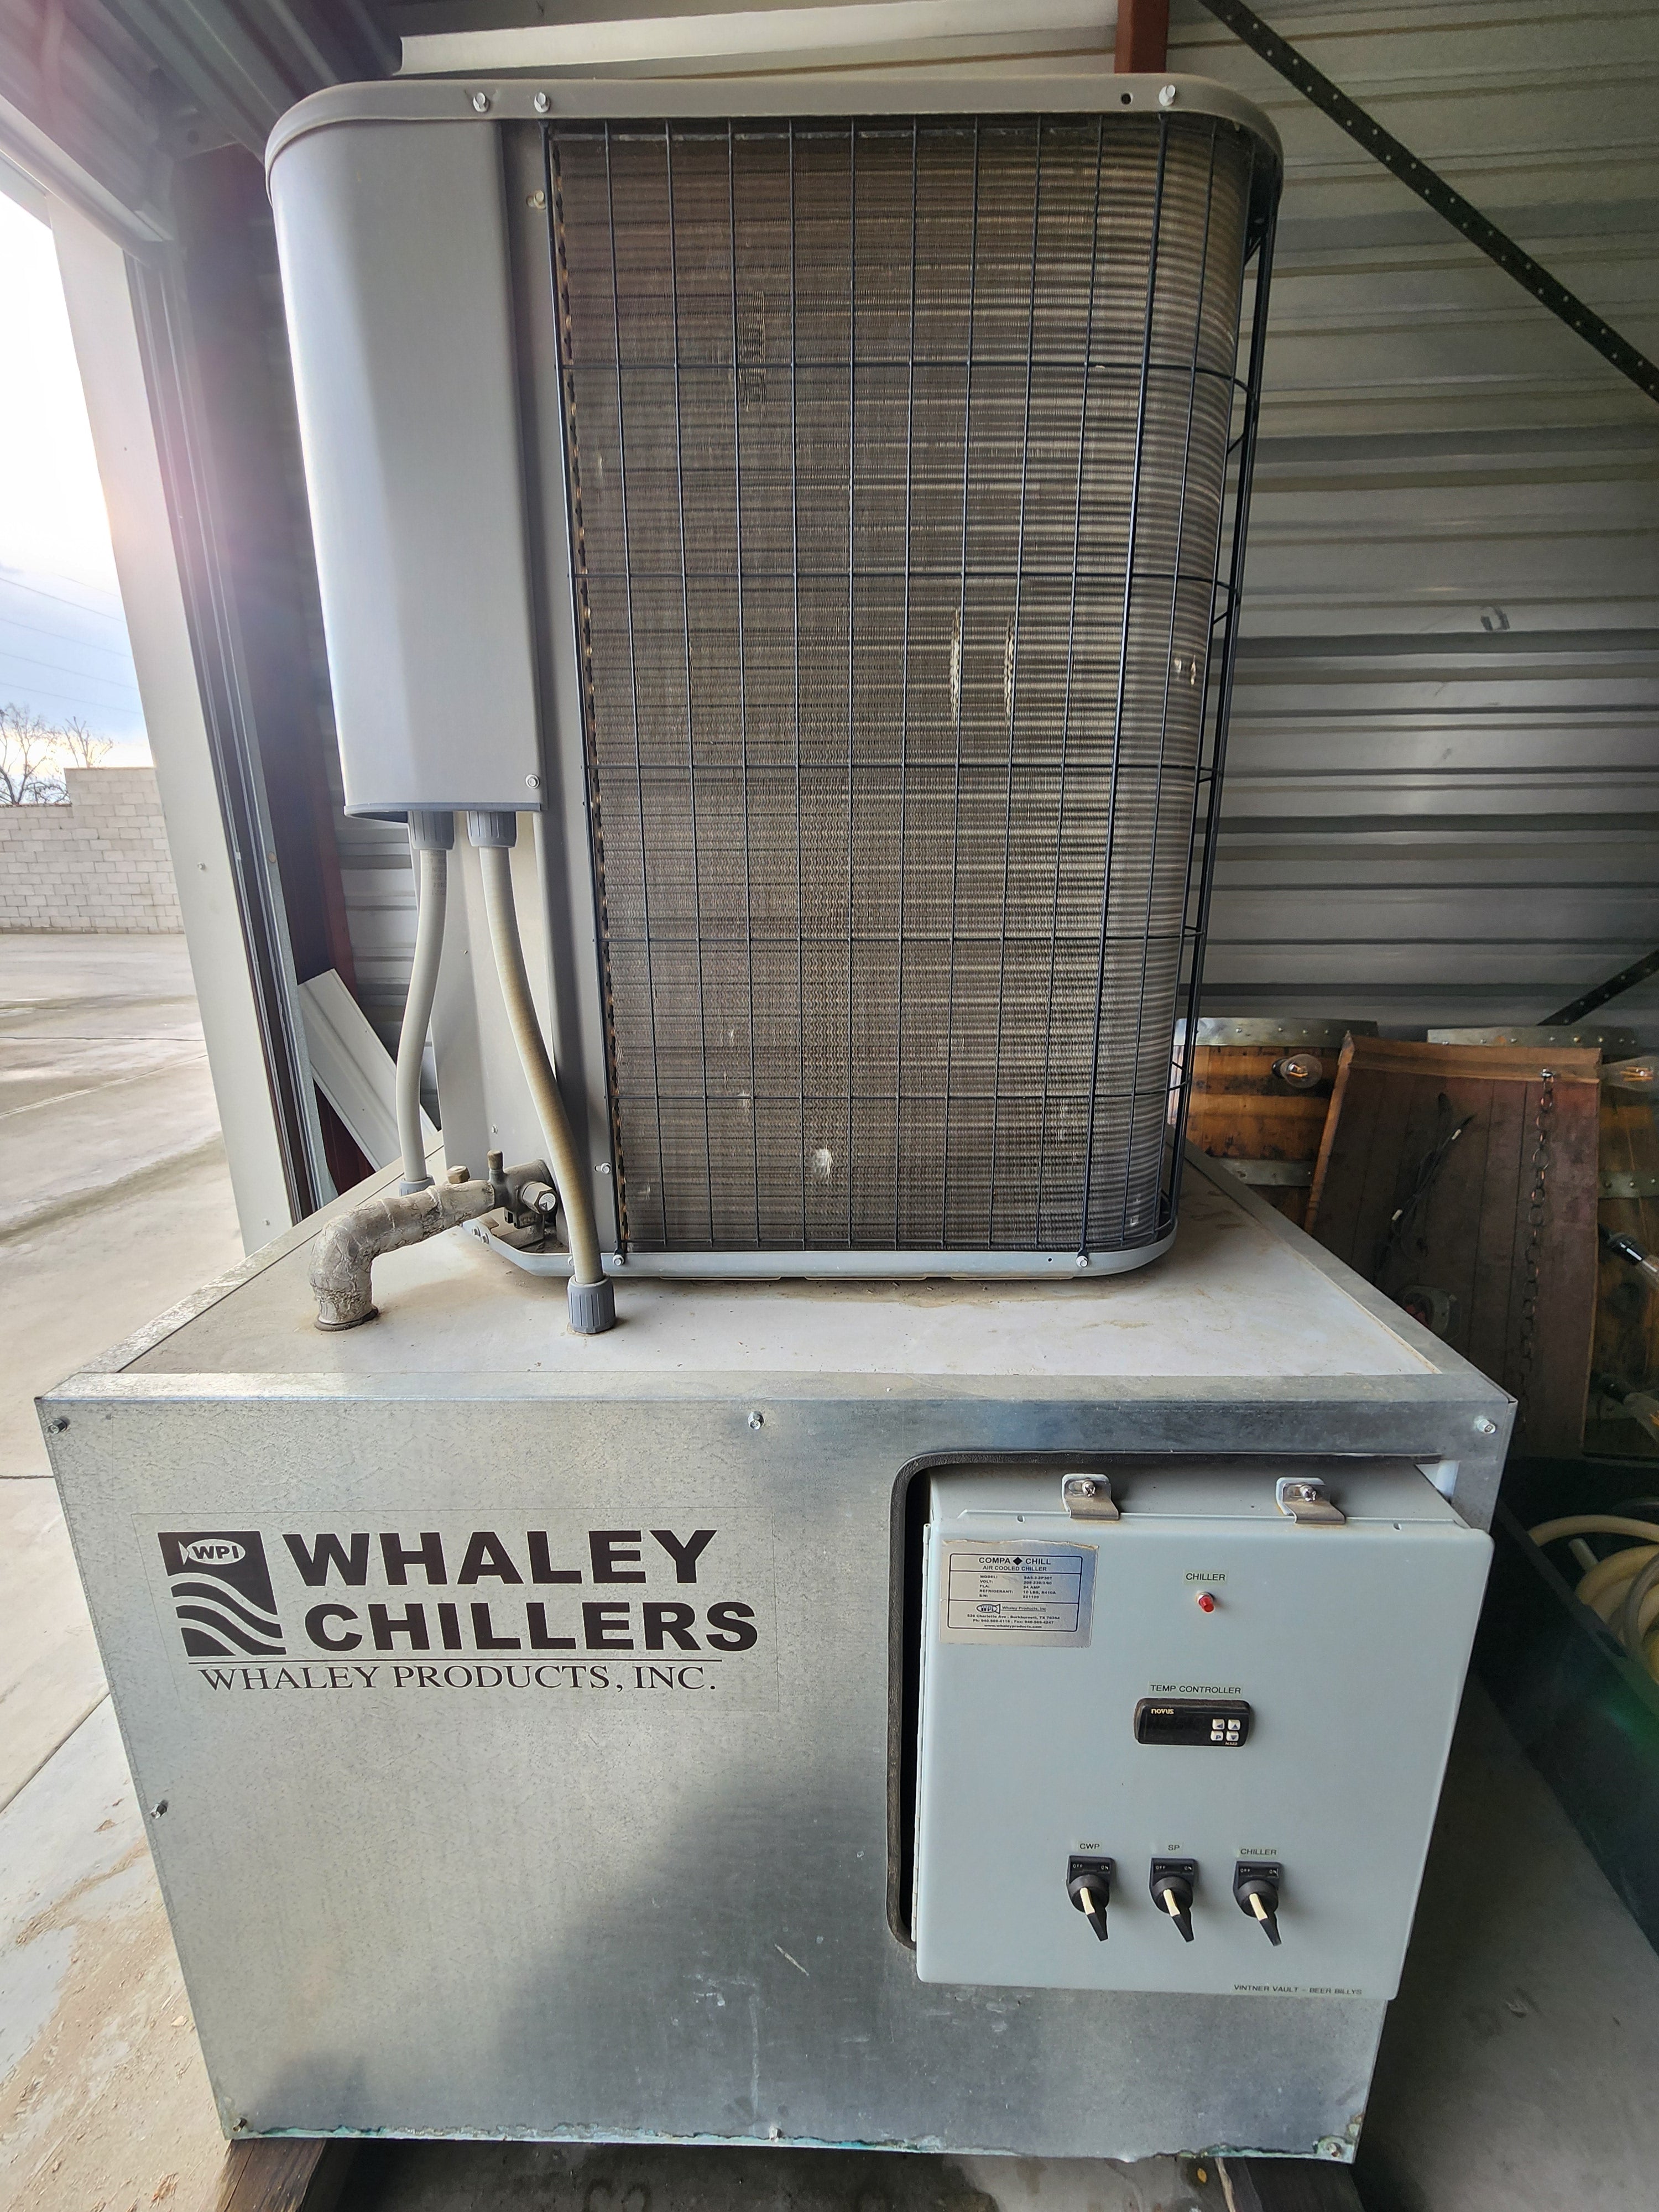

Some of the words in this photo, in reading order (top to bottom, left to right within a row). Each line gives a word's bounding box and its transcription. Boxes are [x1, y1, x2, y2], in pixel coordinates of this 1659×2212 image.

[192, 1545, 239, 1559] WPI
[283, 1530, 717, 1586] WHALEY
[1186, 1573, 1225, 1581] CHILLER
[304, 1601, 758, 1651] CHILLERS
[198, 1666, 378, 1692] WHALEY
[393, 1666, 624, 1692] PRODUCTS,
[635, 1666, 716, 1691] INC.
[1179, 1686, 1241, 1694] CONTROLLER
